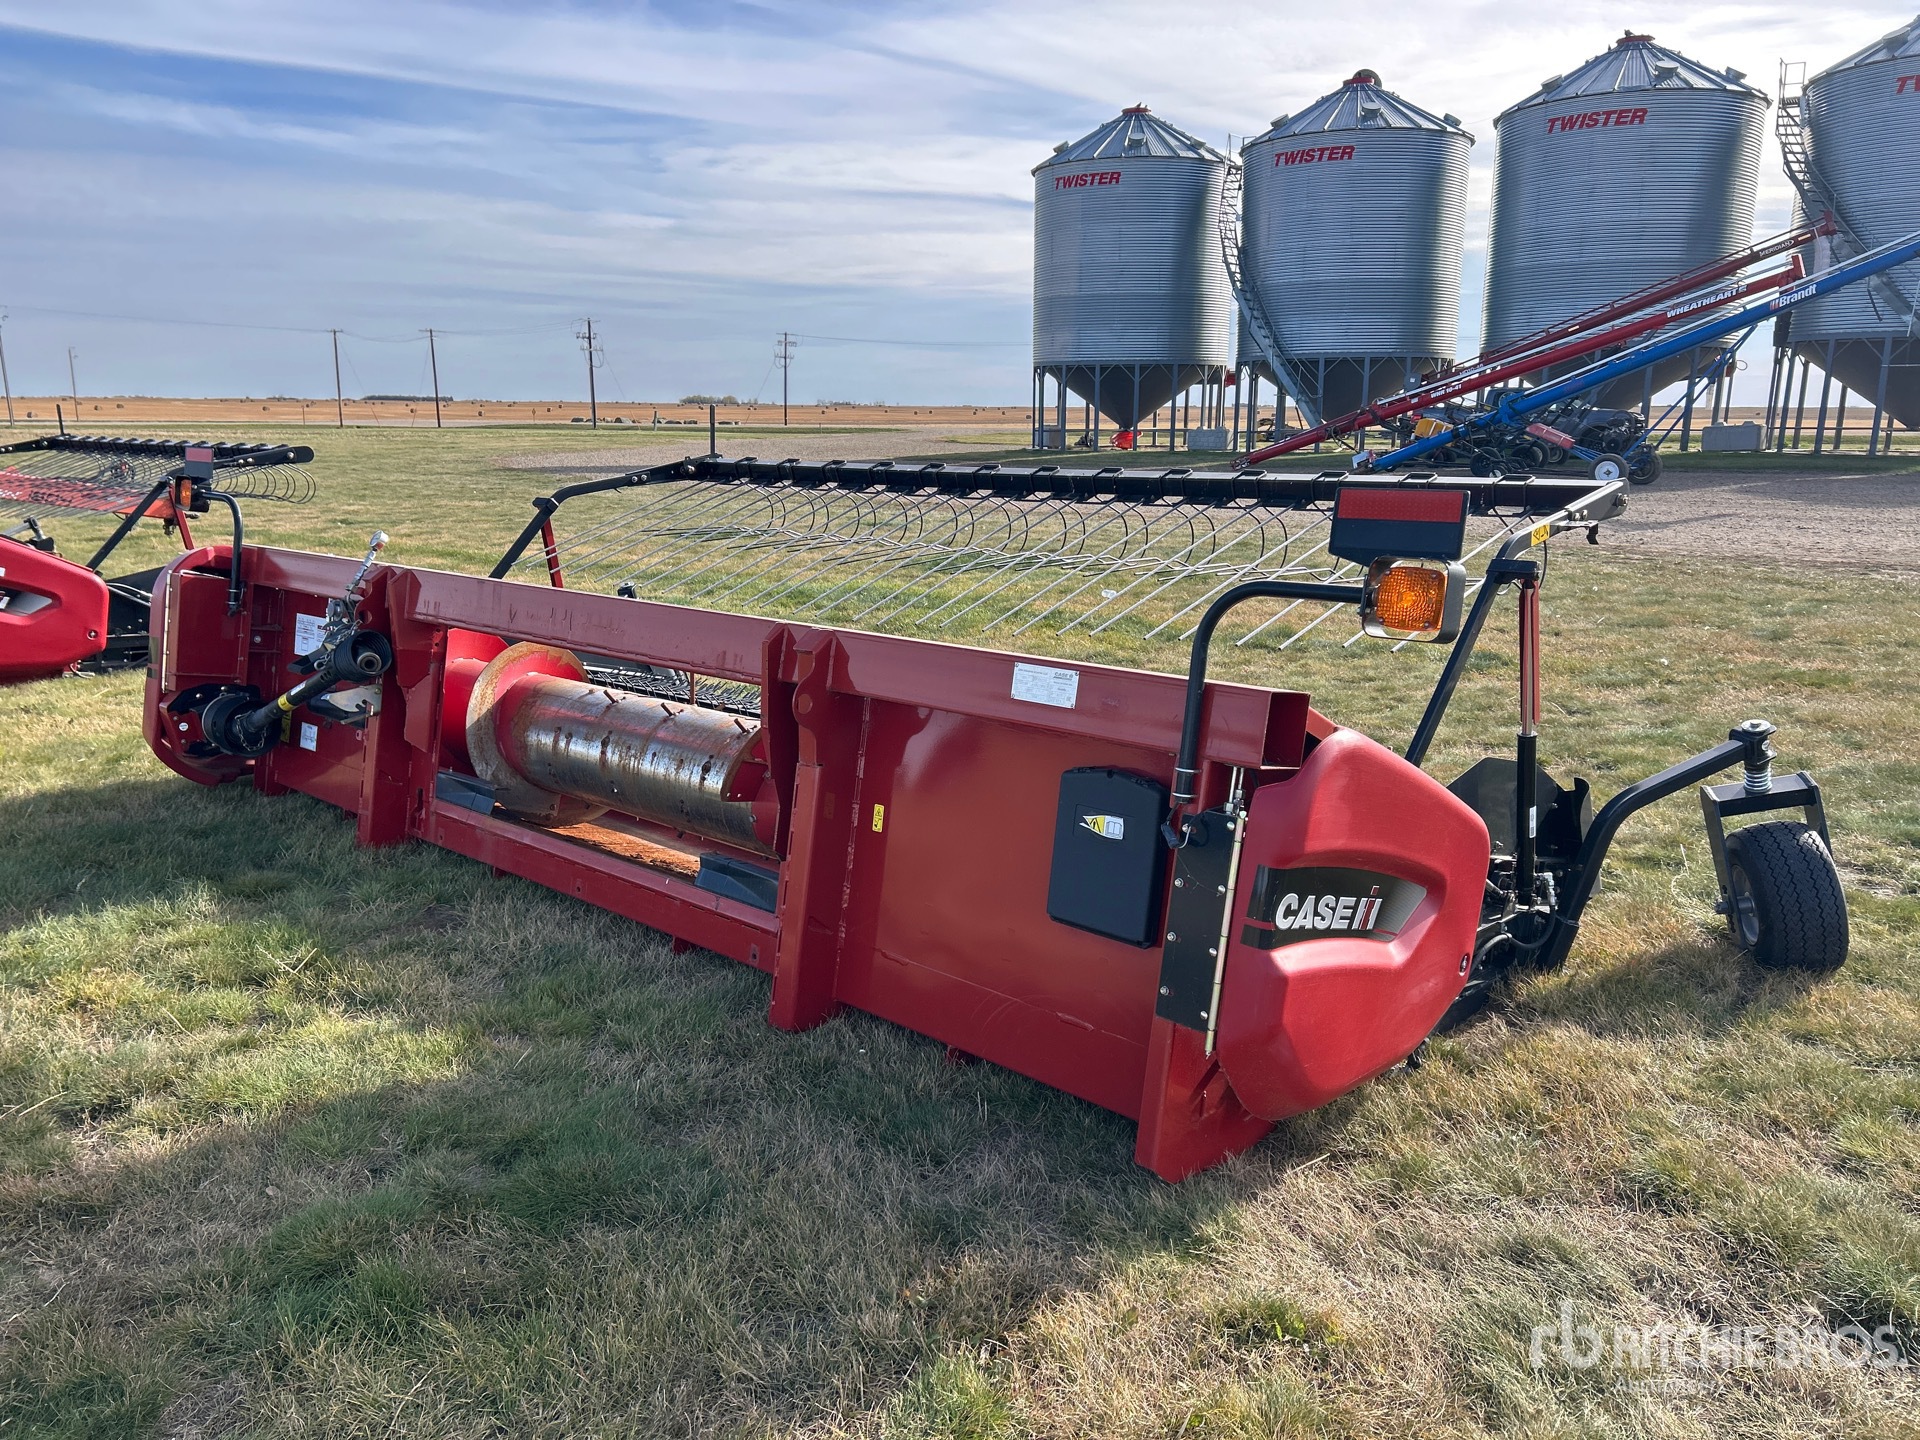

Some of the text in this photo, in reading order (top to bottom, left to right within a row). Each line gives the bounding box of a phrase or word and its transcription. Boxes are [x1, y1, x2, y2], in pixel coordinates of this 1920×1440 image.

[1547, 107, 1649, 134] TWISTER
[1275, 145, 1356, 167] TWISTER
[1055, 171, 1122, 190] TWISTER
[1759, 240, 1793, 256] MERIDIAN
[1666, 288, 1738, 317] WHEATHEART
[1779, 284, 1816, 307] Brandt
